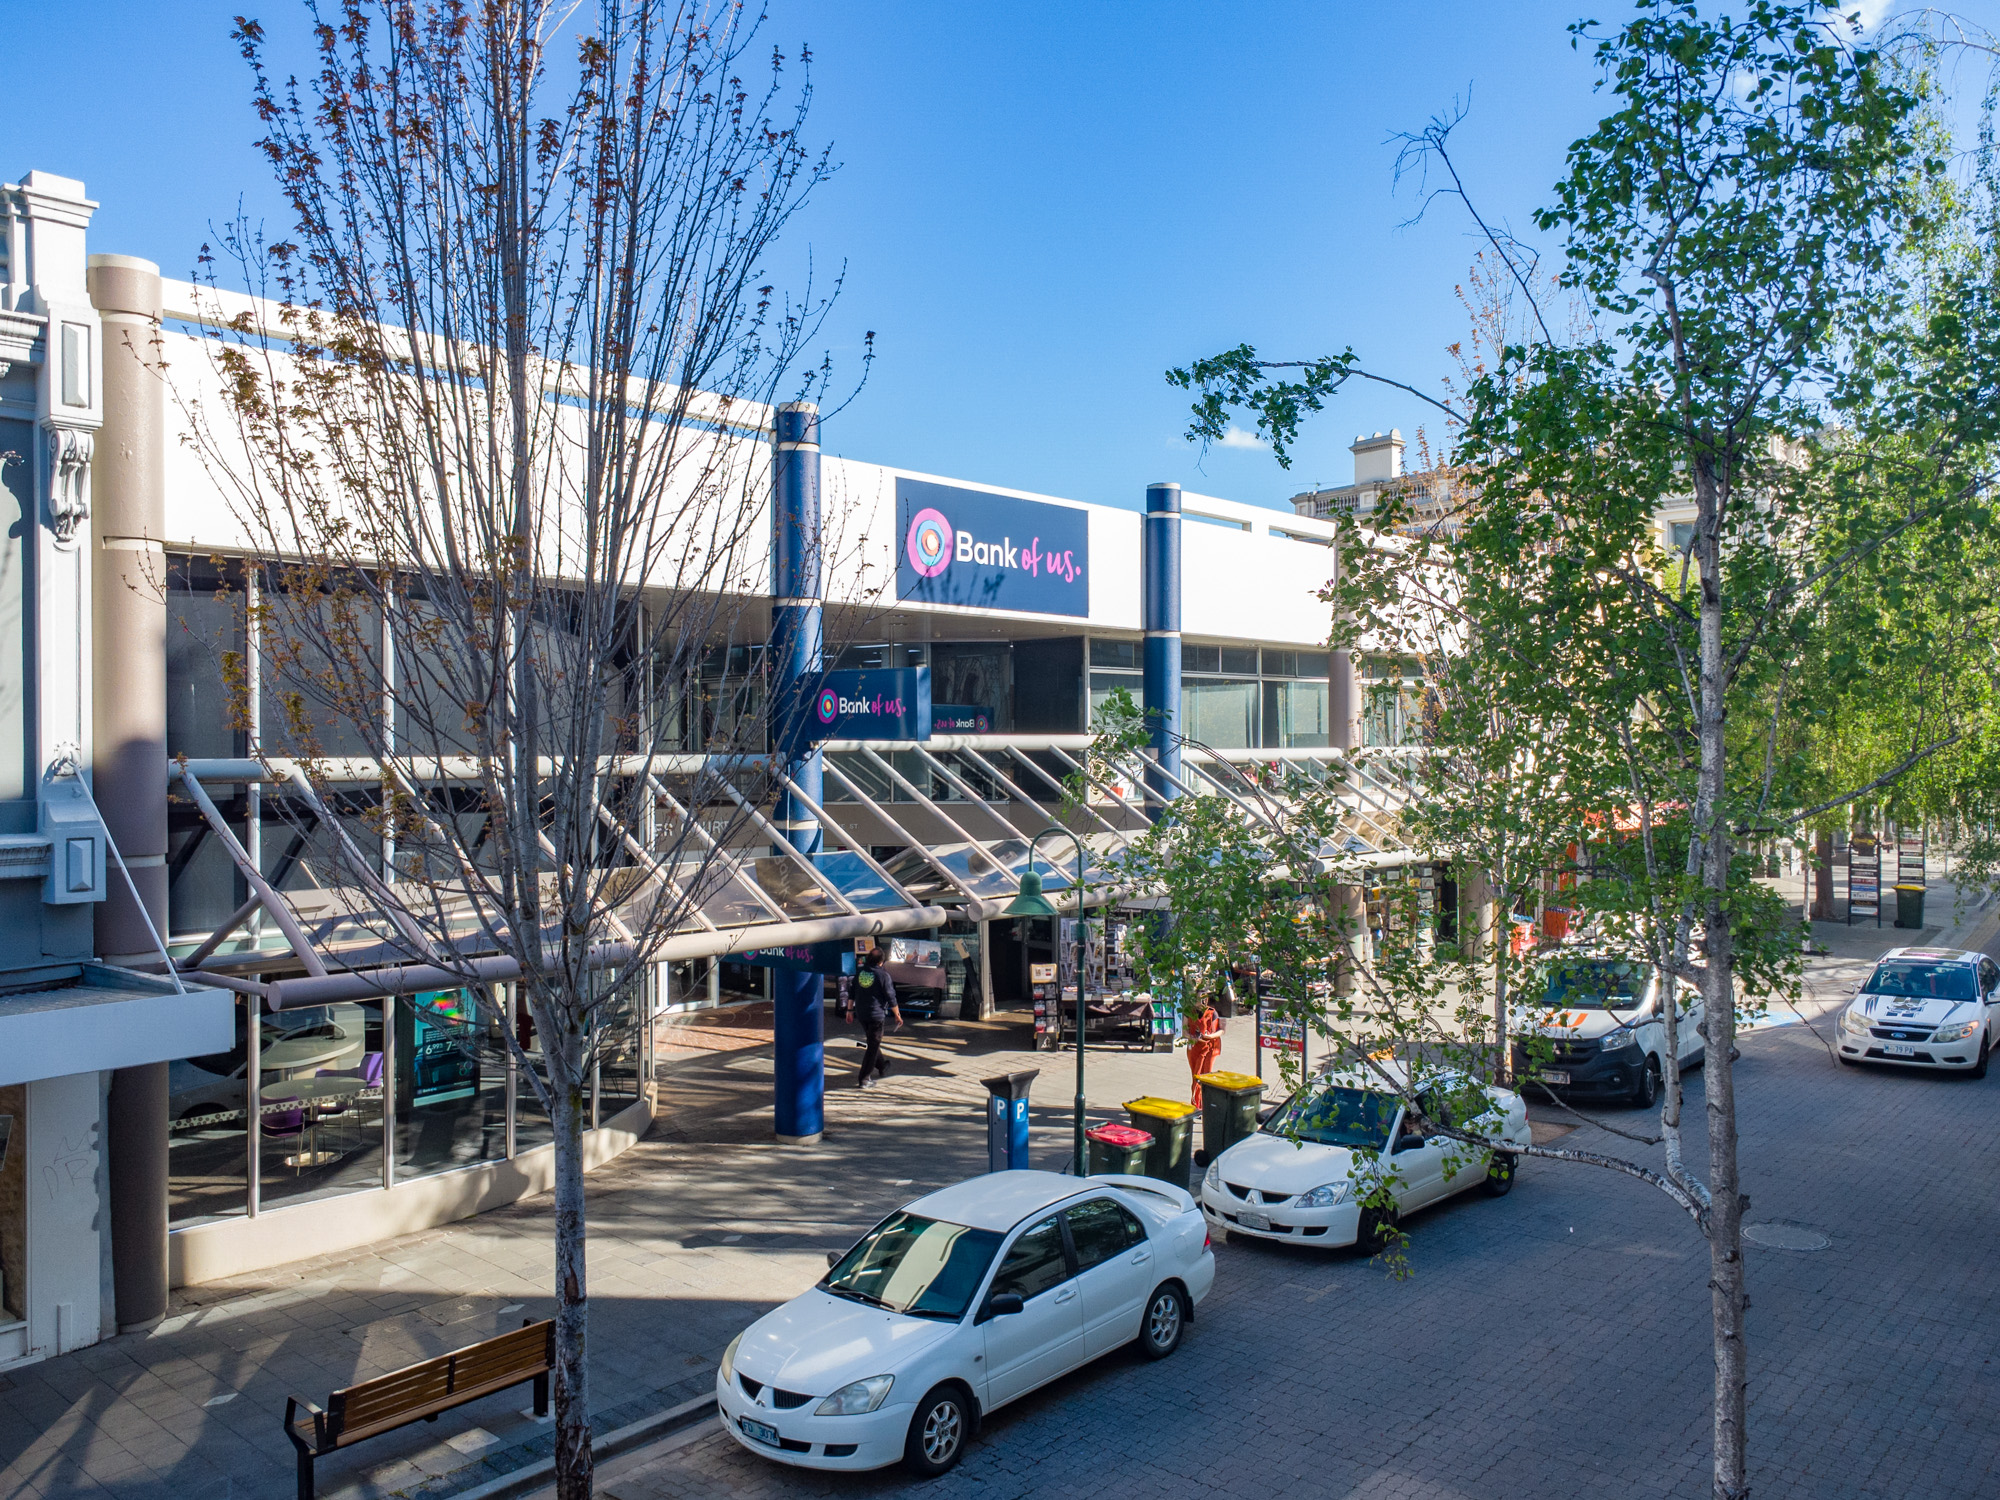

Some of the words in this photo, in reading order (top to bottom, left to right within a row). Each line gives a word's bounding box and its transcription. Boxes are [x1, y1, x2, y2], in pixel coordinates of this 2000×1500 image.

[956, 530, 1018, 569] Bank
[1021, 536, 1043, 578] of
[1046, 550, 1082, 583] us.
[839, 696, 870, 714] Bank
[871, 693, 885, 717] of
[885, 697, 907, 718] us.
[997, 1100, 1005, 1115] P
[1017, 1102, 1025, 1119] P
